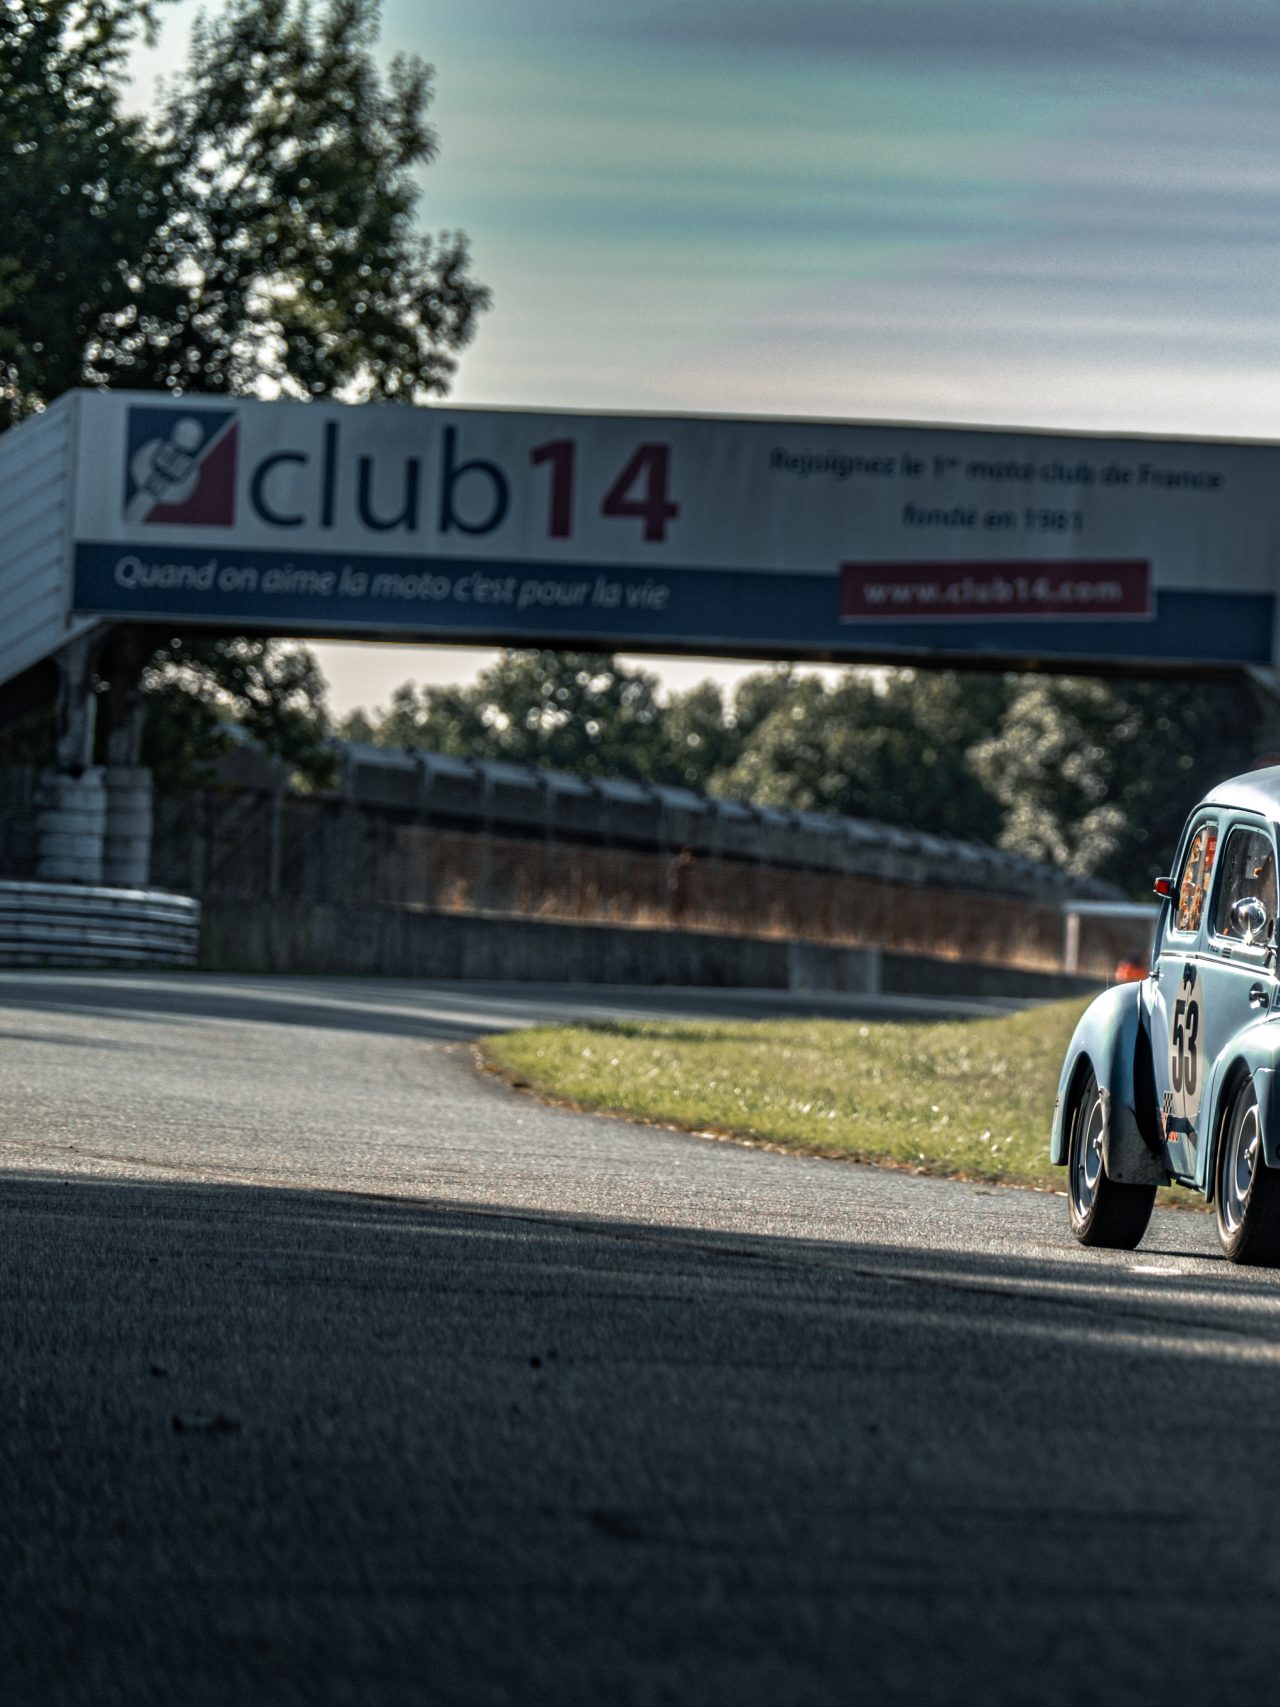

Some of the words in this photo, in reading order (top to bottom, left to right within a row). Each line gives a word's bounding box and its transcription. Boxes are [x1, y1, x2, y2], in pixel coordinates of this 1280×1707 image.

[249, 418, 680, 544] club14
[901, 453, 926, 480] le
[965, 460, 1036, 484] moto
[1040, 458, 1097, 486] club
[1100, 462, 1136, 488] de
[1137, 462, 1226, 493] France
[983, 510, 1018, 532] en
[113, 555, 218, 590] Quand
[217, 566, 259, 592] on
[262, 562, 336, 596] aime
[337, 563, 369, 598] la
[370, 571, 451, 602] moto
[516, 577, 593, 612] pour
[592, 575, 622, 608] la
[625, 578, 671, 611] vie
[863, 577, 1123, 605] www.club14.com
[1172, 998, 1199, 1096] 53
